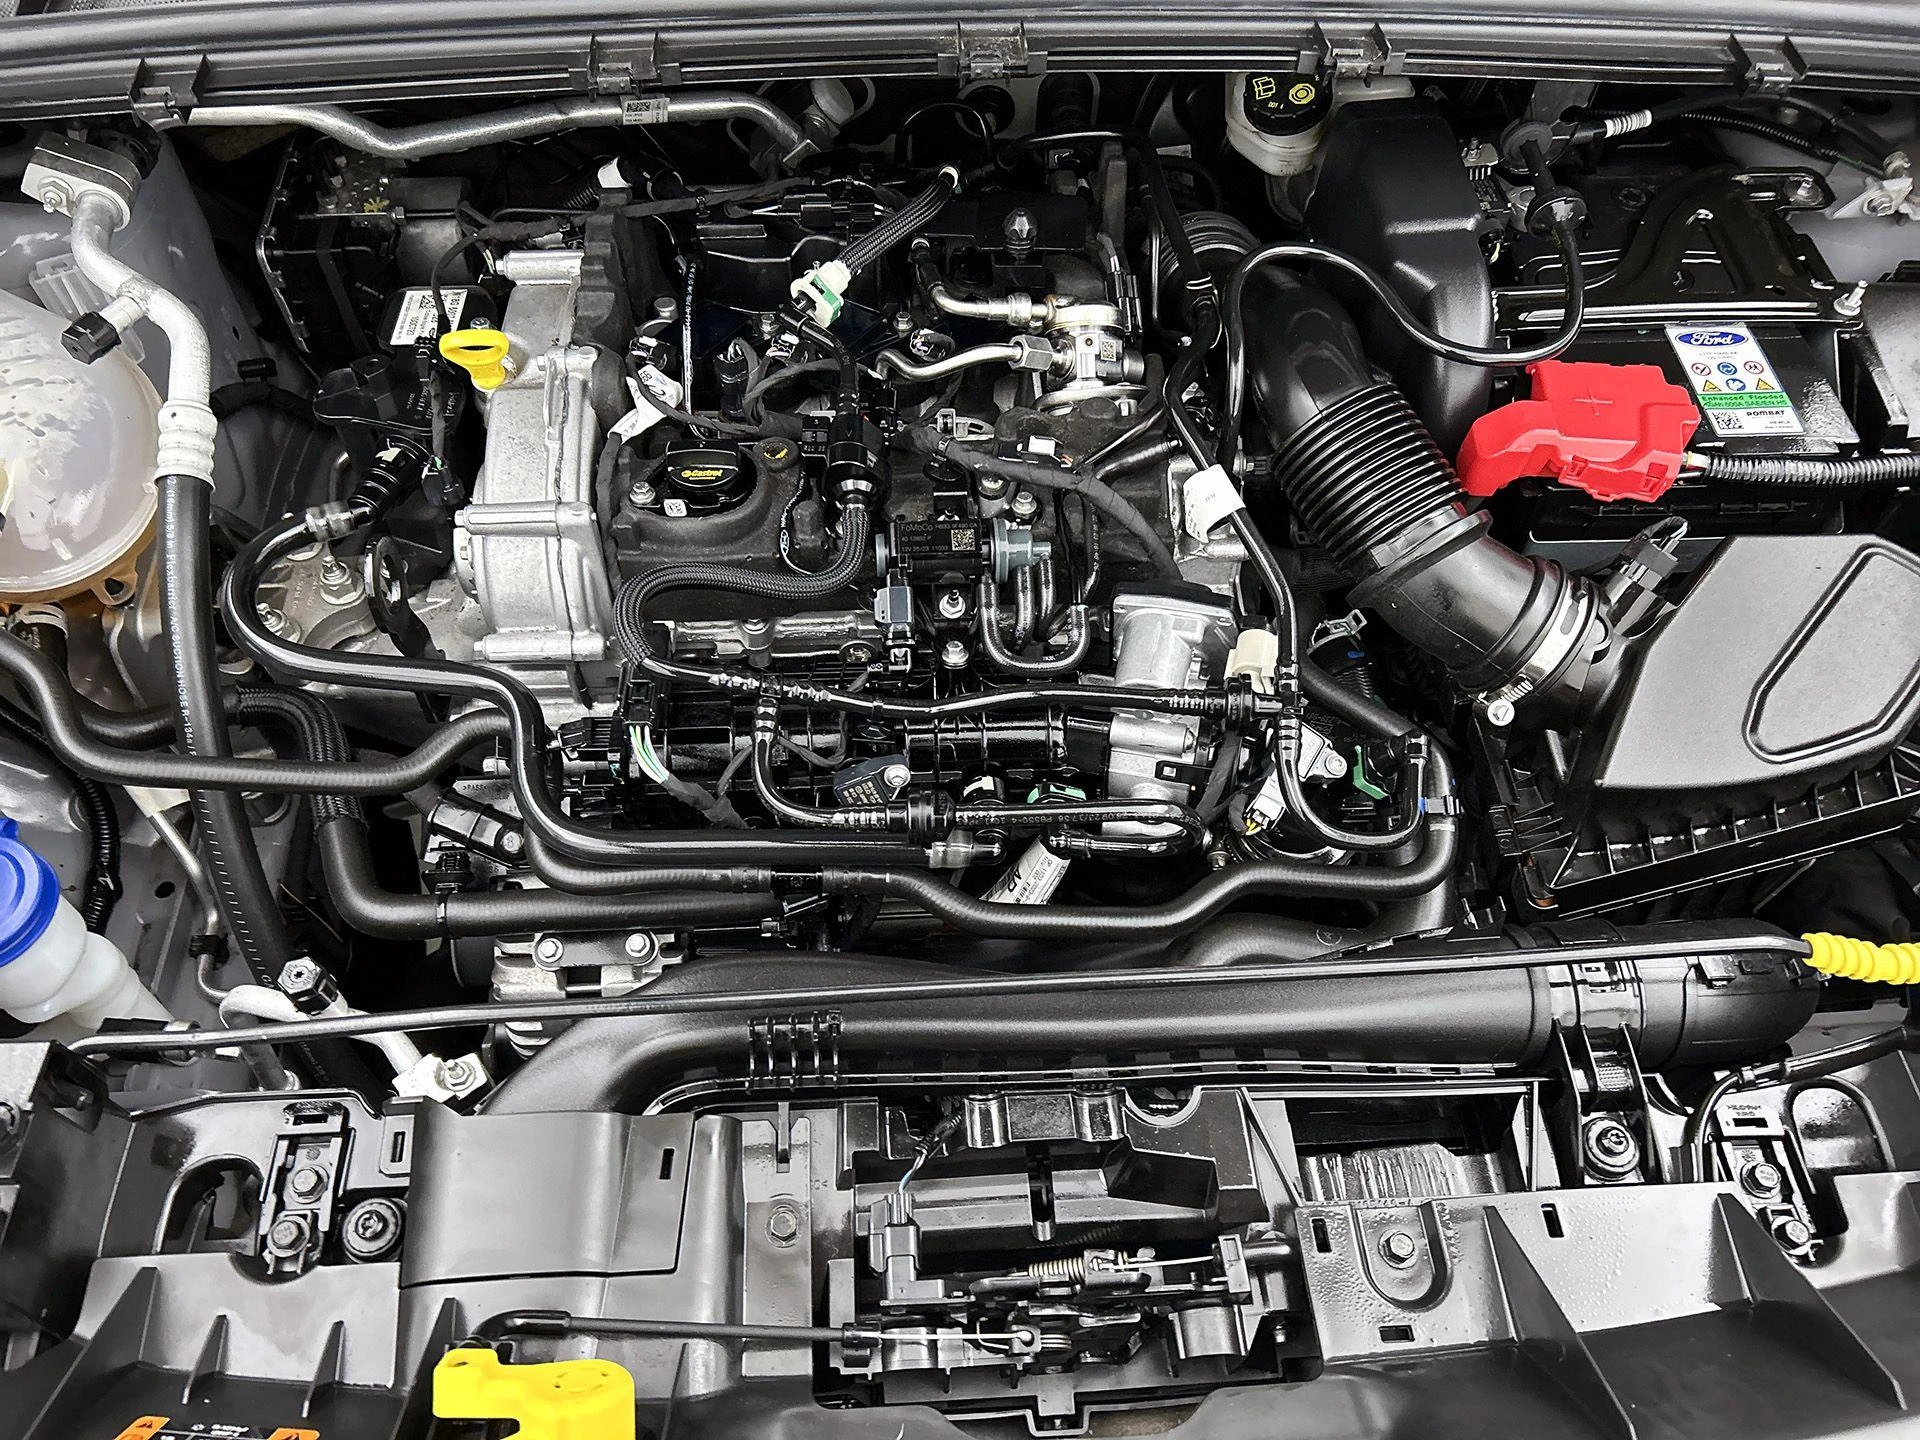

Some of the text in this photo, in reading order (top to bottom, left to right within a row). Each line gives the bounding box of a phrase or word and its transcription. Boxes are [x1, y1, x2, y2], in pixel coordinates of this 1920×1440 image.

[1690, 331, 1735, 346] Ford
[691, 469, 723, 477] Castrol
[901, 523, 934, 532] FoMoCo
[166, 554, 178, 610] Flexbarrier
[170, 615, 180, 633] A/C
[171, 634, 184, 678] SUCTION
[177, 679, 188, 707] HOSE
[181, 709, 194, 744] R-134a
